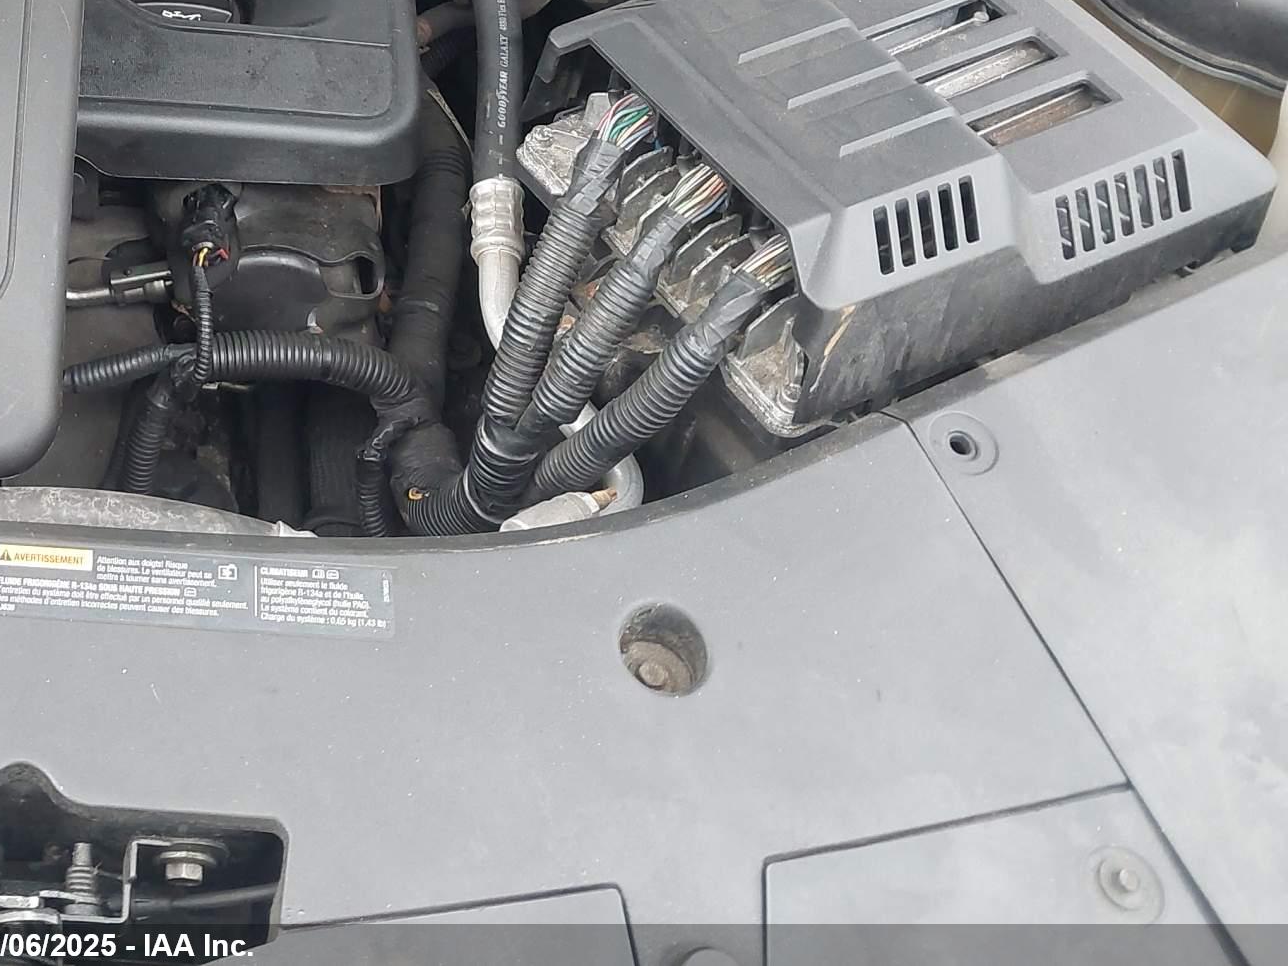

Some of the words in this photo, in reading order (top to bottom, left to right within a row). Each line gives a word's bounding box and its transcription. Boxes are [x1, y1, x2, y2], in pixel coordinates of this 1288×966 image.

[499, 34, 509, 67] GALAXY
[496, 71, 509, 128] GOODYEAR
[14, 552, 84, 565] AVERTISSEMENT
